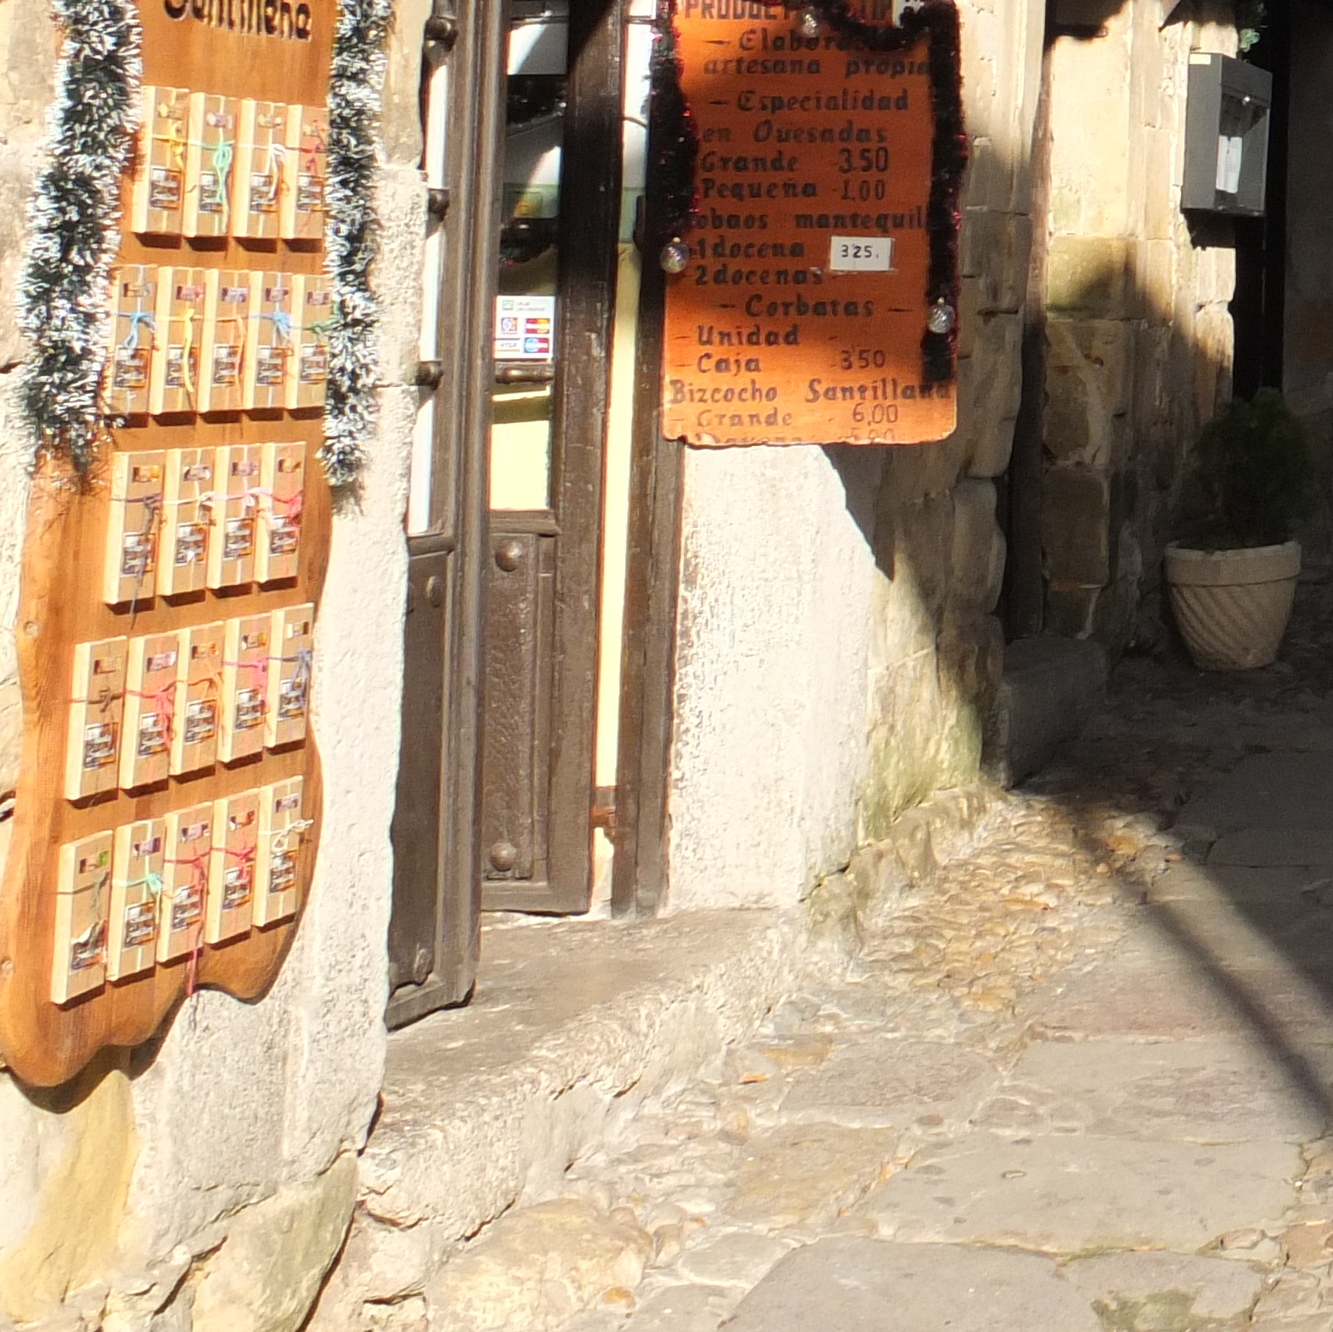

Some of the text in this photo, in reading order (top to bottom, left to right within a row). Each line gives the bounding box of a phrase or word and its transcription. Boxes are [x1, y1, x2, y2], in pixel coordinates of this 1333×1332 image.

[704, 55, 821, 75] artesana
[737, 88, 909, 114] Especialidad
[703, 127, 731, 143] en
[702, 149, 799, 172] Grande
[692, 205, 931, 234] obaos mantequil
[745, 292, 875, 318] Corbatas
[697, 324, 801, 346] Unidad
[697, 352, 762, 377] Caja
[669, 377, 952, 405] Bizcocho Santillana
[695, 406, 793, 427] Grande
